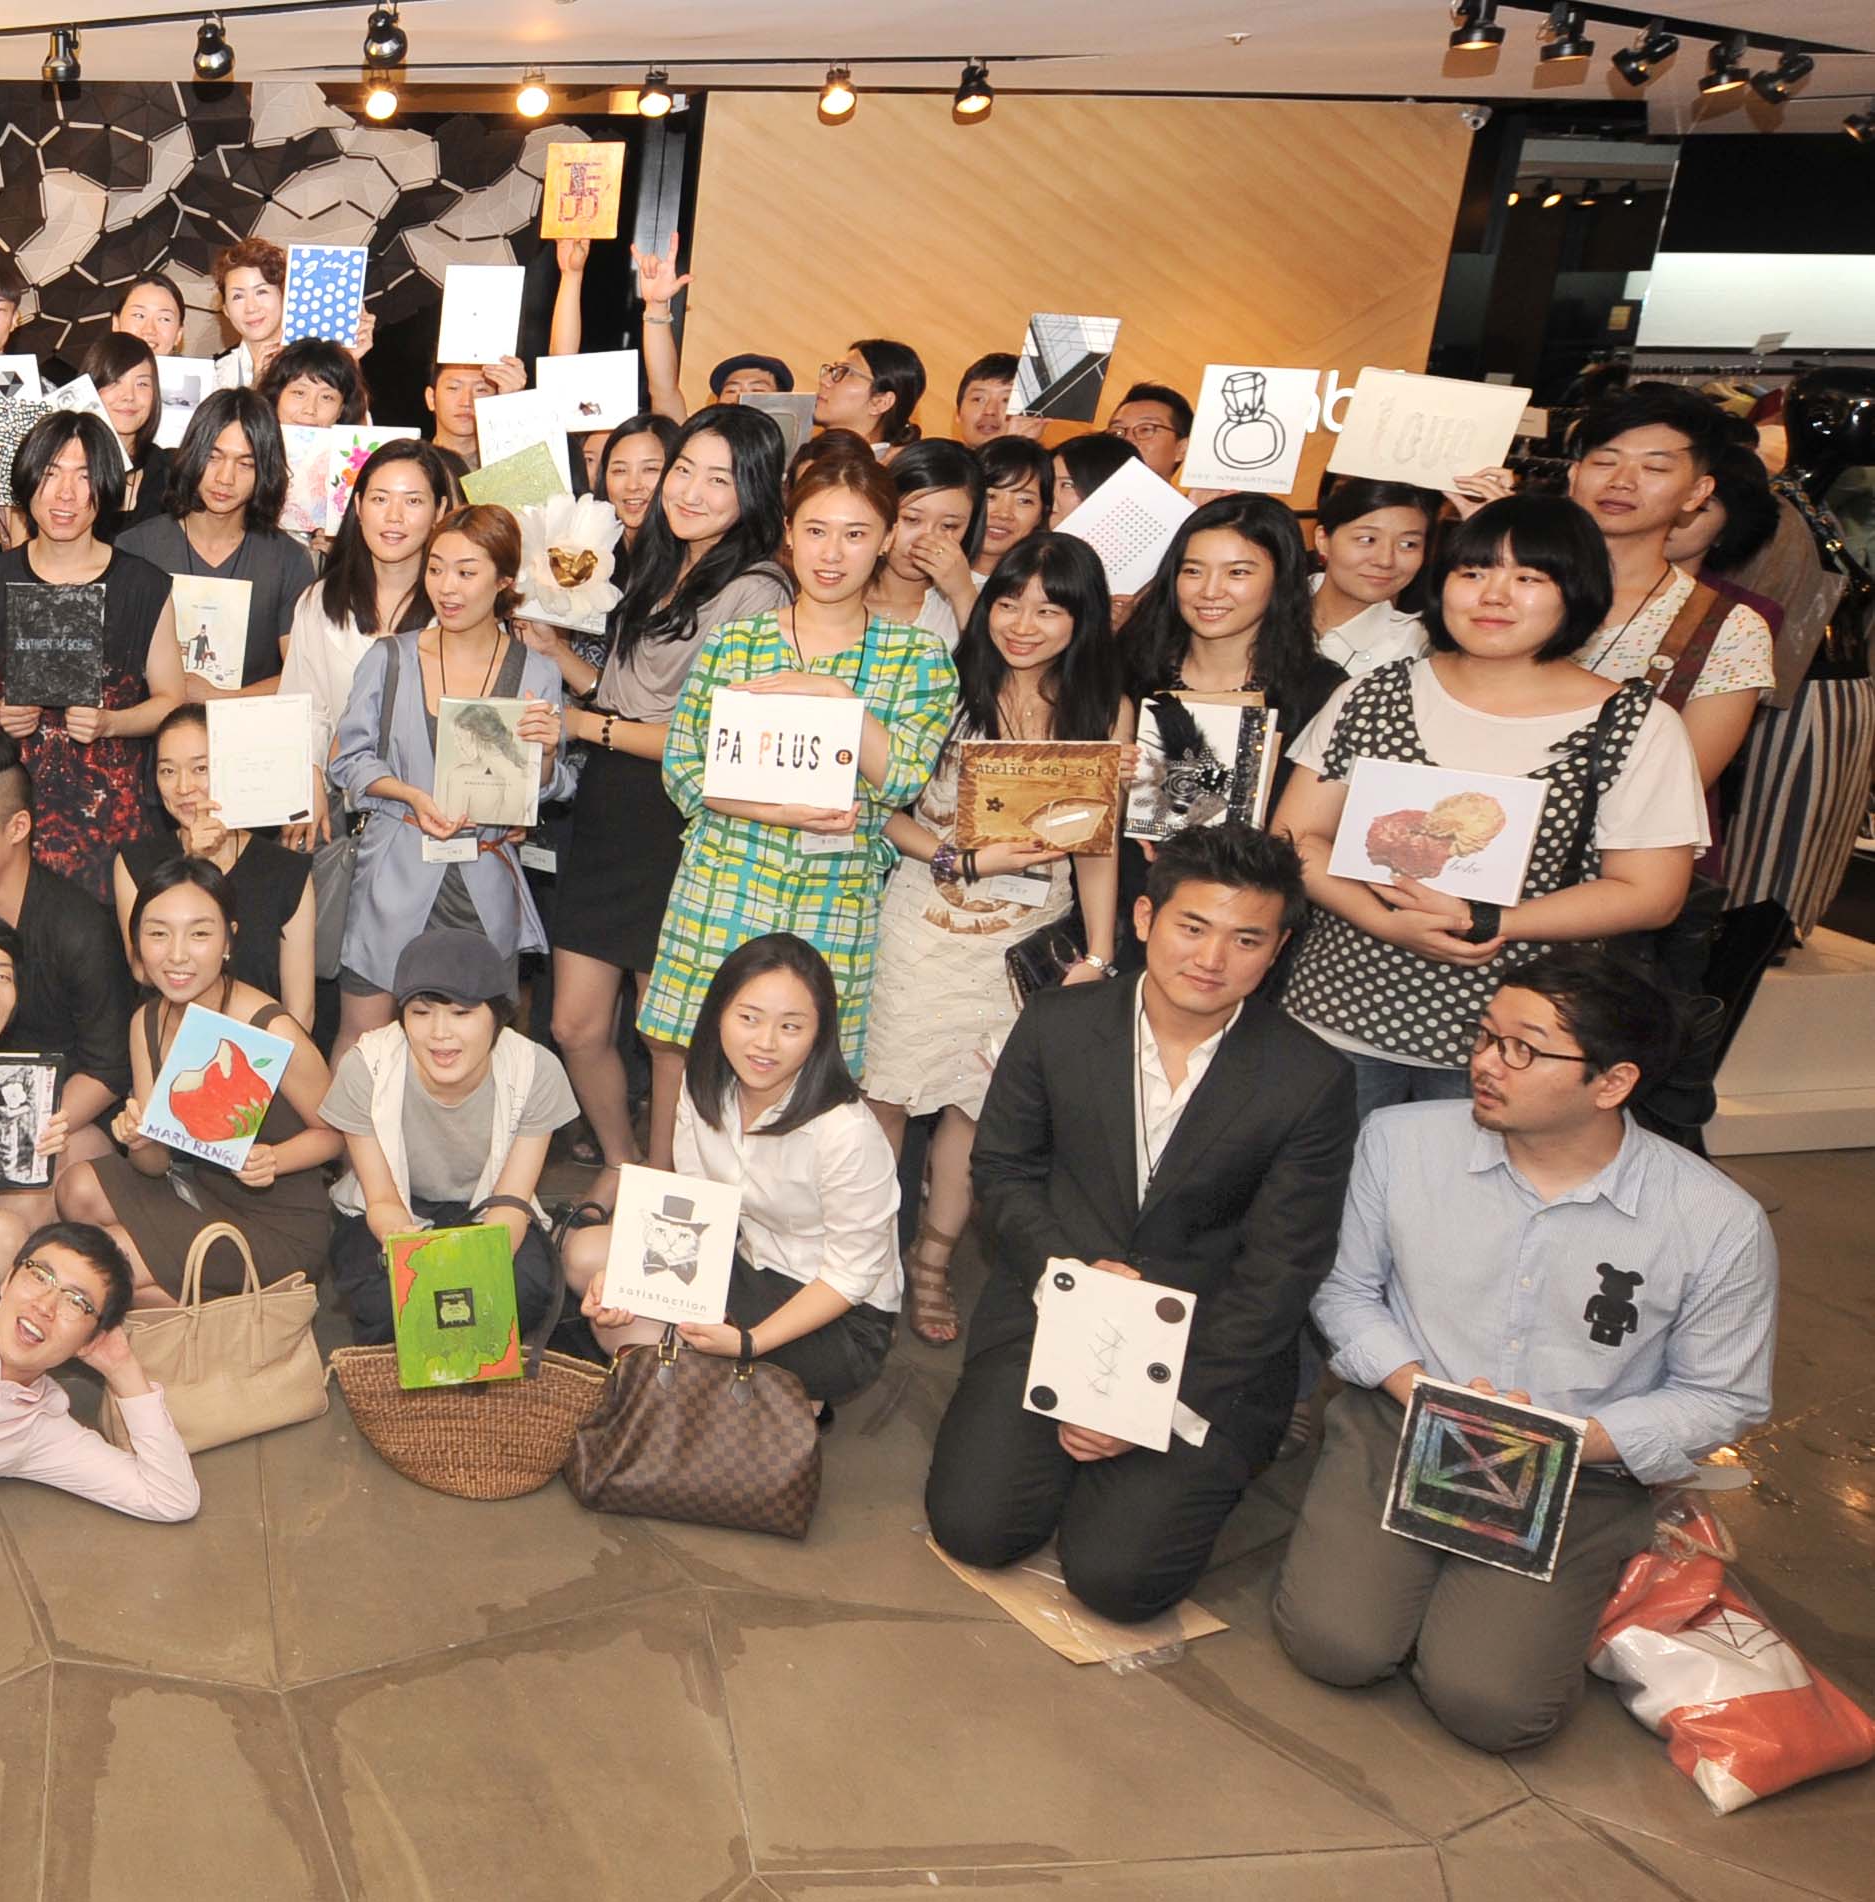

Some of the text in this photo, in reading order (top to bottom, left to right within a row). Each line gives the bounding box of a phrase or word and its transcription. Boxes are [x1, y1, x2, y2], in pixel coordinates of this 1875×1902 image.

[716, 728, 742, 764] PA
[758, 731, 822, 770] PLUS
[975, 763, 1103, 777] Atelier del sol
[146, 1124, 189, 1148] MARY
